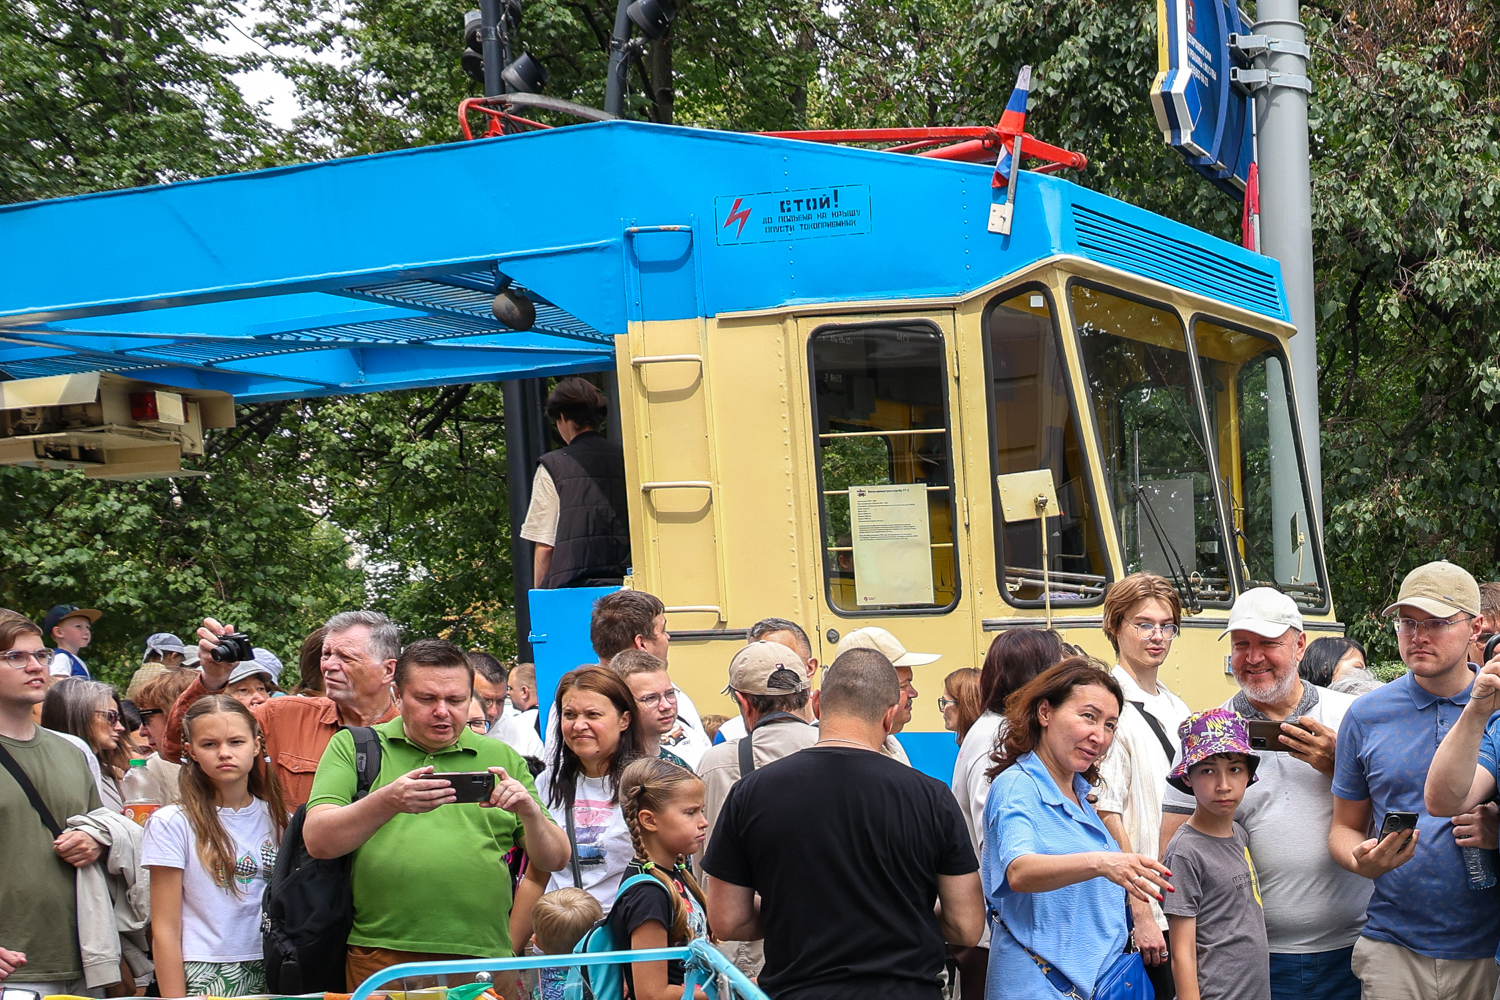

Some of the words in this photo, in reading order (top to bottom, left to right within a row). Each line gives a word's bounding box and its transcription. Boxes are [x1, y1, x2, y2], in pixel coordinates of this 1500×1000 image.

[779, 189, 839, 213] СТОЙ!
[762, 216, 773, 224] ДО
[816, 212, 827, 220] НА
[831, 209, 861, 218] КРЫШУ
[764, 225, 795, 234] ОПУСТИ
[799, 219, 857, 231] ТОКОПРИЕМНИК
